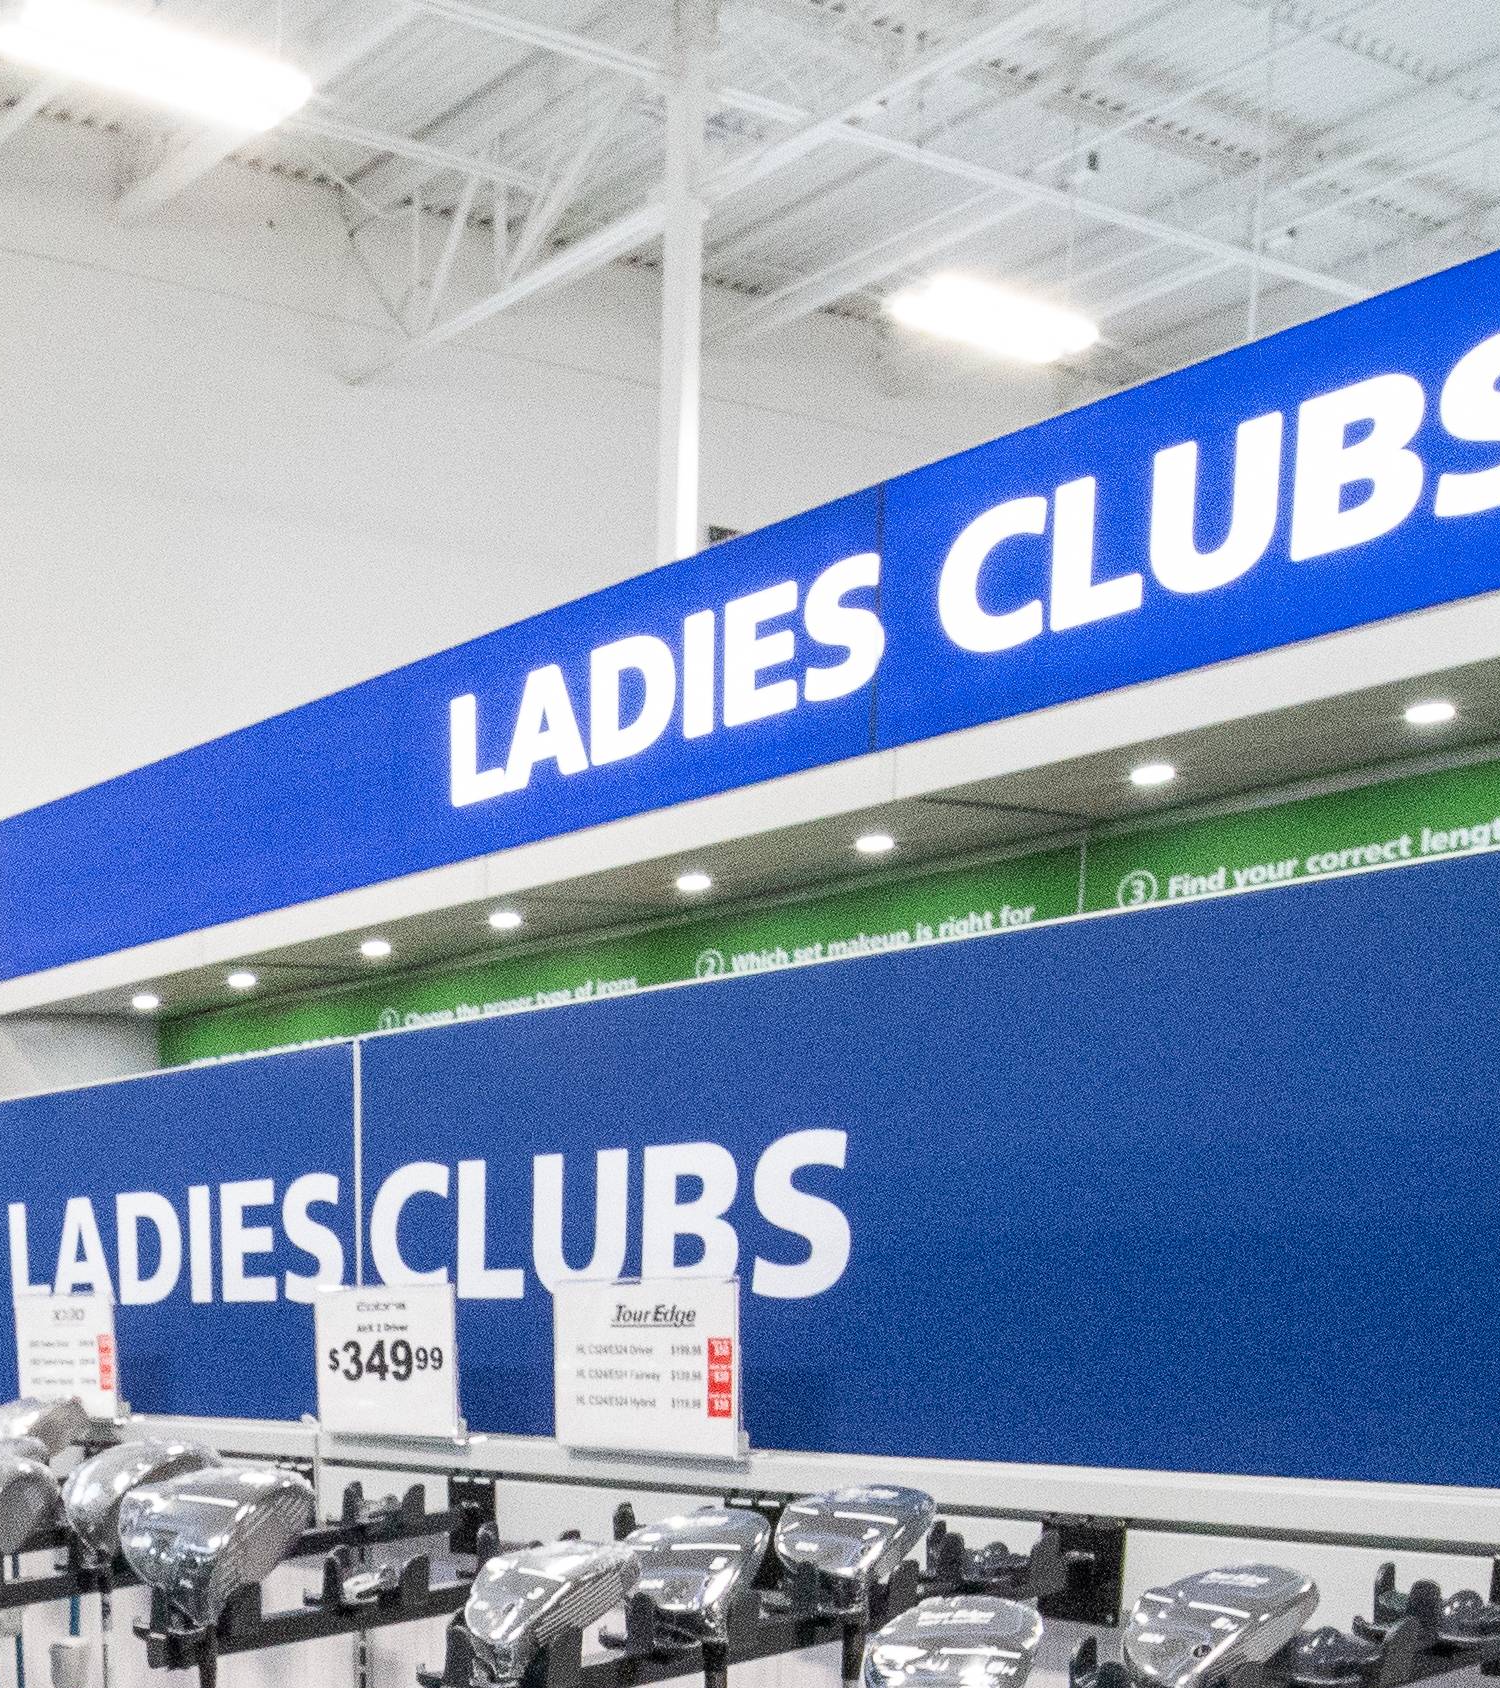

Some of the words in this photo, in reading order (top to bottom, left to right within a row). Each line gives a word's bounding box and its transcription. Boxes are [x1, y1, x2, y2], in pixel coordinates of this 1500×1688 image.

[446, 551, 886, 808] LADIES
[1167, 868, 1226, 900] Find
[1232, 854, 1295, 888] your
[1306, 836, 1412, 873] correct
[731, 948, 788, 973] Which
[793, 943, 822, 965] set
[916, 922, 933, 942] is
[999, 904, 1037, 928] for
[7, 1172, 344, 1305] LADIES
[369, 1128, 853, 1300] CLUBS
[613, 1303, 649, 1323] Tour
[651, 1303, 697, 1328] Edge
